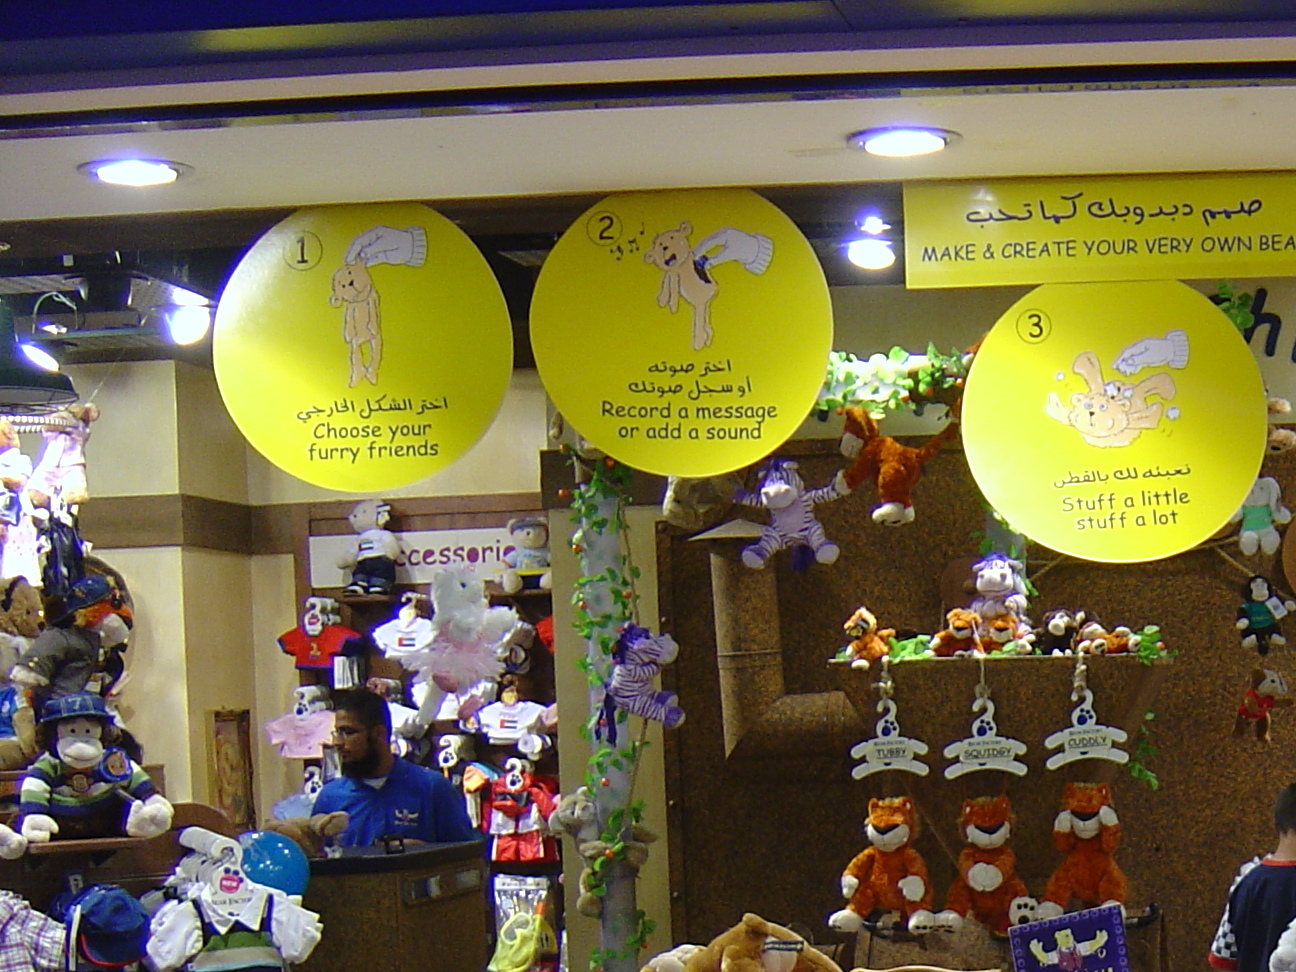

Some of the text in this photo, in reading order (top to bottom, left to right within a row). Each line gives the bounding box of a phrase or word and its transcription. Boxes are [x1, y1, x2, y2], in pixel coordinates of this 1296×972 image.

[598, 215, 615, 241] 2
[296, 236, 310, 264] 1
[921, 243, 976, 262] MAKE
[982, 244, 995, 260] &
[1001, 239, 1077, 259] CREATE
[1083, 238, 1138, 257] YOUR
[1144, 236, 1194, 255] VERY
[1200, 234, 1253, 254] OWN
[1027, 313, 1044, 338] 3
[602, 401, 777, 423] Record a message
[313, 422, 432, 443] Choose your
[618, 422, 762, 440] or add a sound
[308, 440, 439, 464] furry friends
[1062, 487, 1190, 512] Stuff a little
[1077, 509, 1178, 531] stuff a lot
[876, 747, 907, 758] TUBBY
[964, 746, 1012, 759] SQUIDGY
[1067, 736, 1107, 748] CUDDLY
